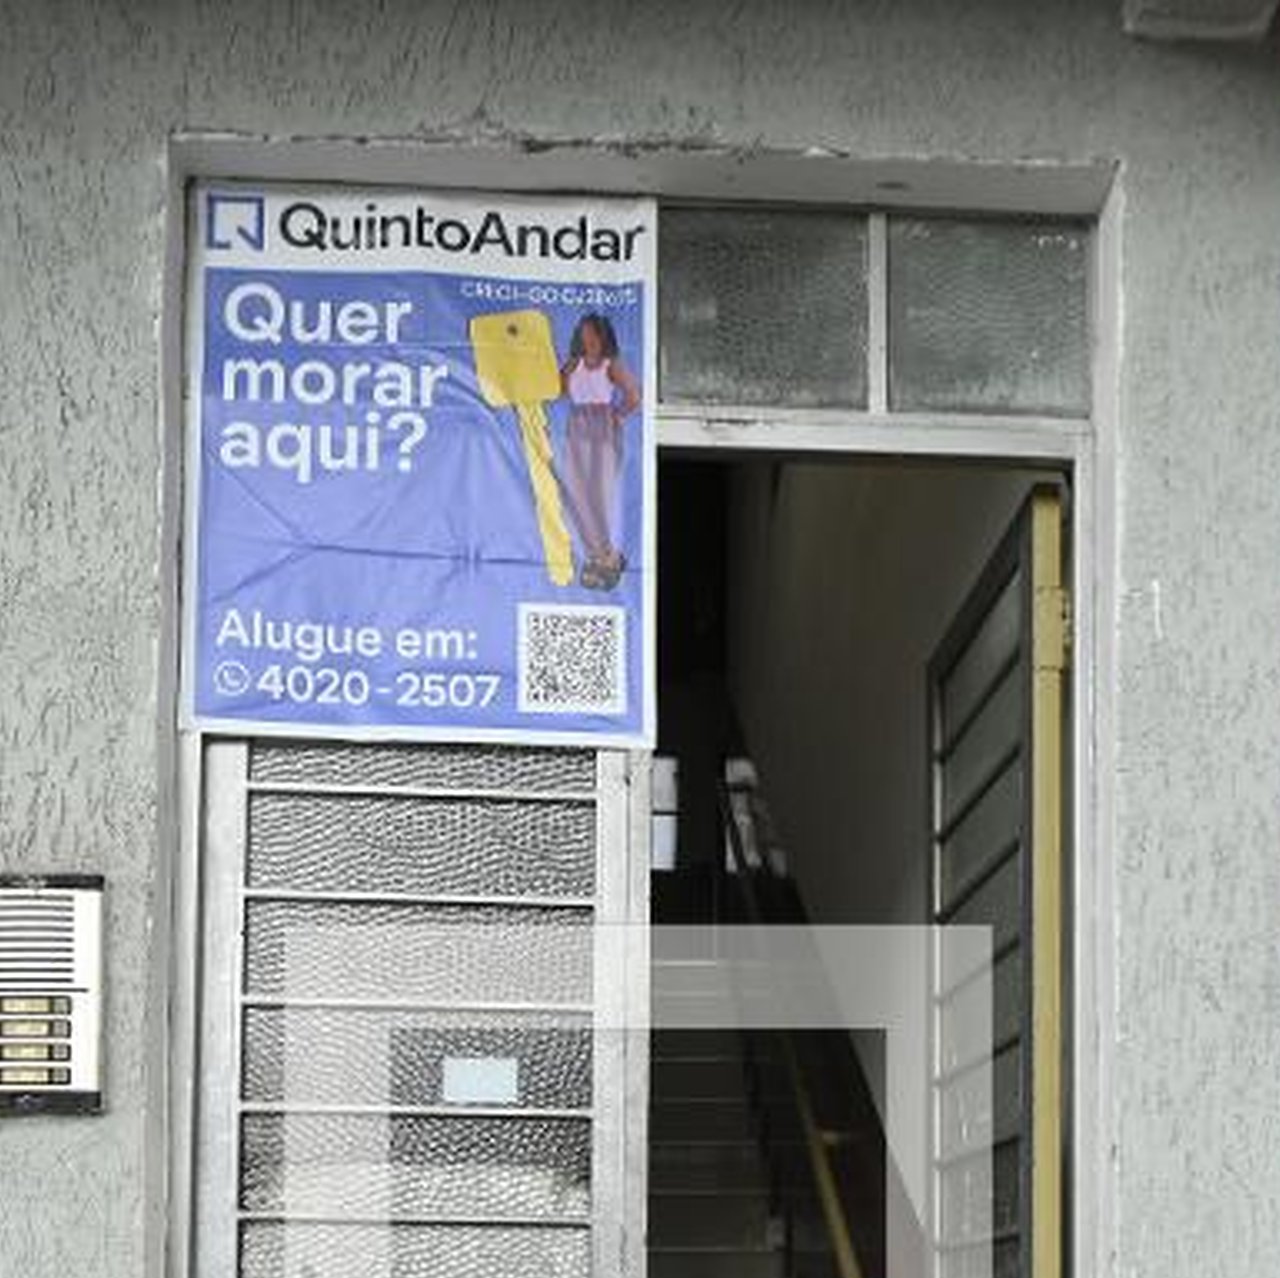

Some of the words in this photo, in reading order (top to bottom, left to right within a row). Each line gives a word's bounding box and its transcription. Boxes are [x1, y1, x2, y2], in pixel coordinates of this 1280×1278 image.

[278, 202, 646, 262] QuintoAndar
[224, 282, 412, 344] Quer
[222, 358, 449, 407] morar
[220, 411, 428, 483] aqui?
[216, 608, 382, 661] Alugue
[395, 625, 478, 660] em:
